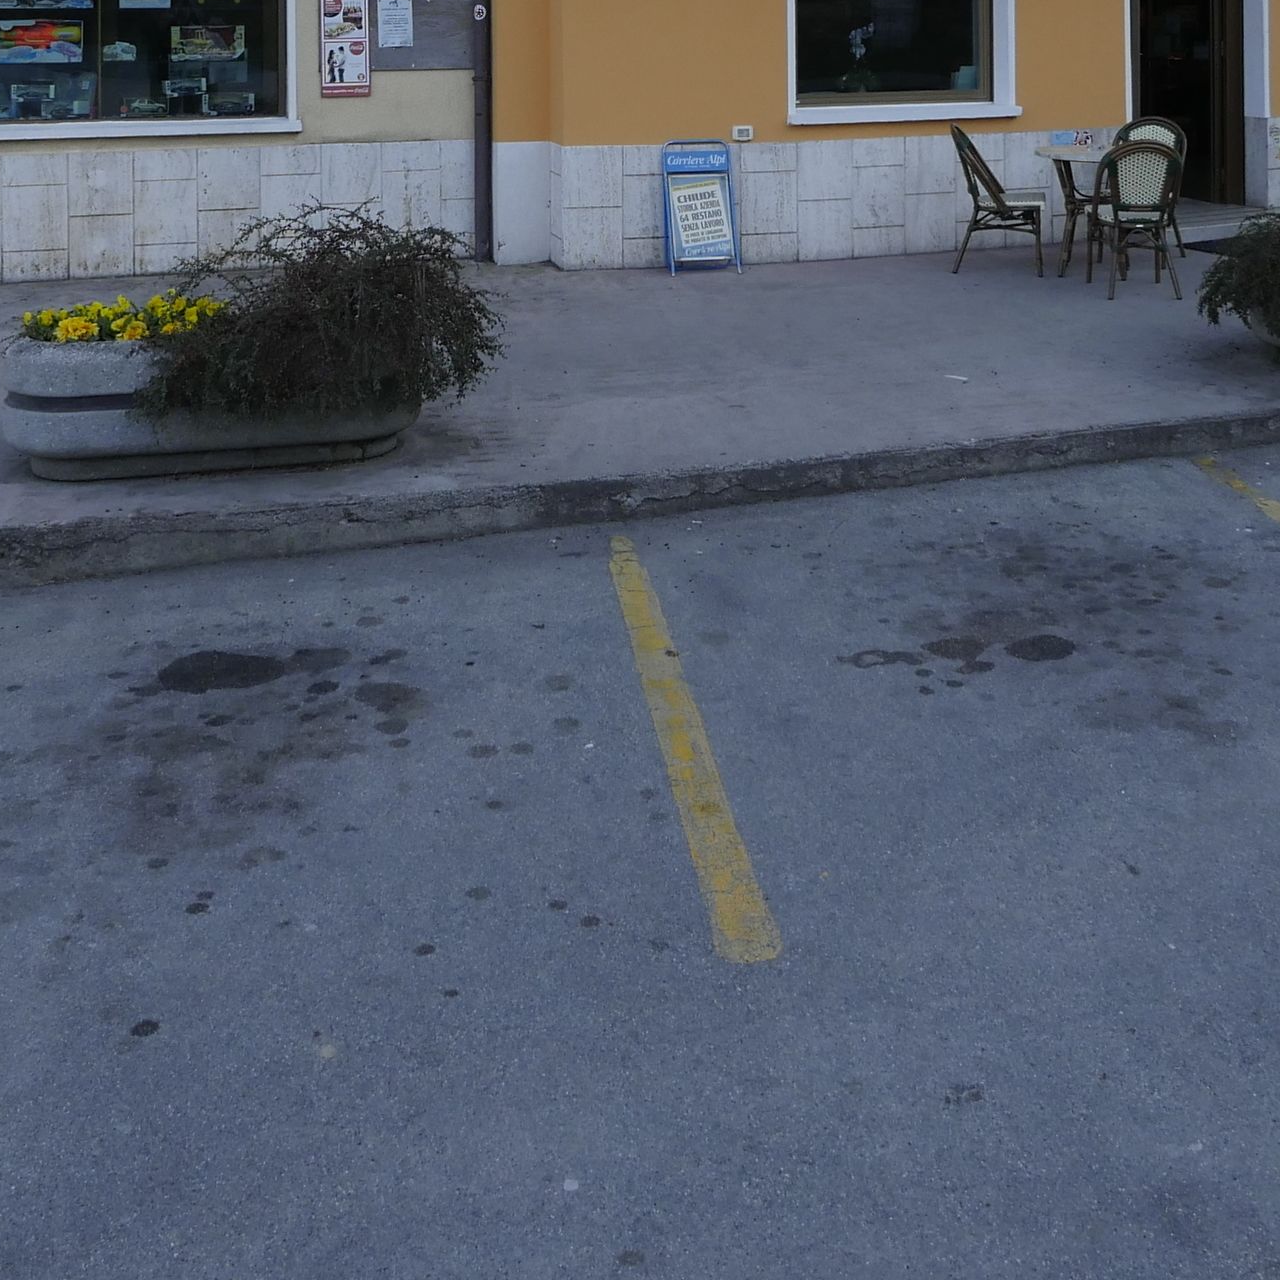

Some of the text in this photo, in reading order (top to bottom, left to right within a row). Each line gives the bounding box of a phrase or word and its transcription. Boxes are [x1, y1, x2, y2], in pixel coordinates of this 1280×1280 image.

[667, 154, 705, 166] Corriere
[677, 190, 718, 204] CHIUDE
[680, 208, 723, 223] 64 RESTANO
[681, 217, 725, 233] SENZA LAVORO
